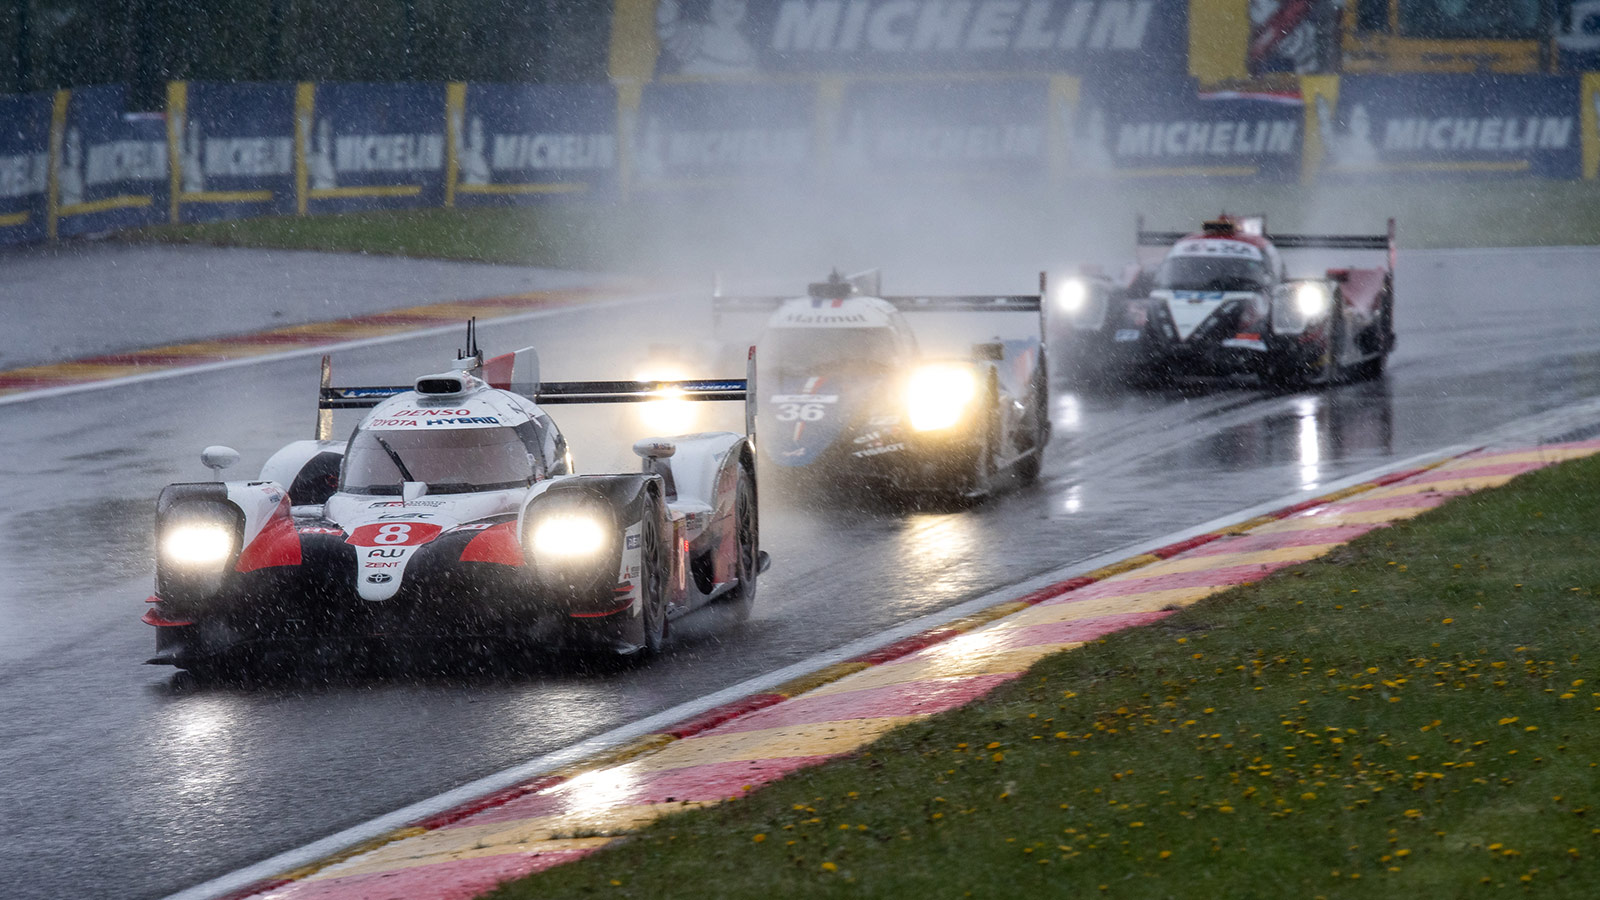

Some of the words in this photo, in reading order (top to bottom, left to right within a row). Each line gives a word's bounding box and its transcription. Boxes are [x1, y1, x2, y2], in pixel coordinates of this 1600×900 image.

[771, 0, 1152, 50] MICHELIN
[1117, 120, 1297, 156] MICHELIN
[1384, 117, 1573, 150] MICHELIN
[493, 134, 614, 168] MICHELIN
[371, 419, 417, 427] TOYOTA
[426, 416, 499, 426] HYBRID
[393, 409, 470, 417] DENSO
[776, 403, 825, 421] 36
[373, 524, 412, 544] 8
